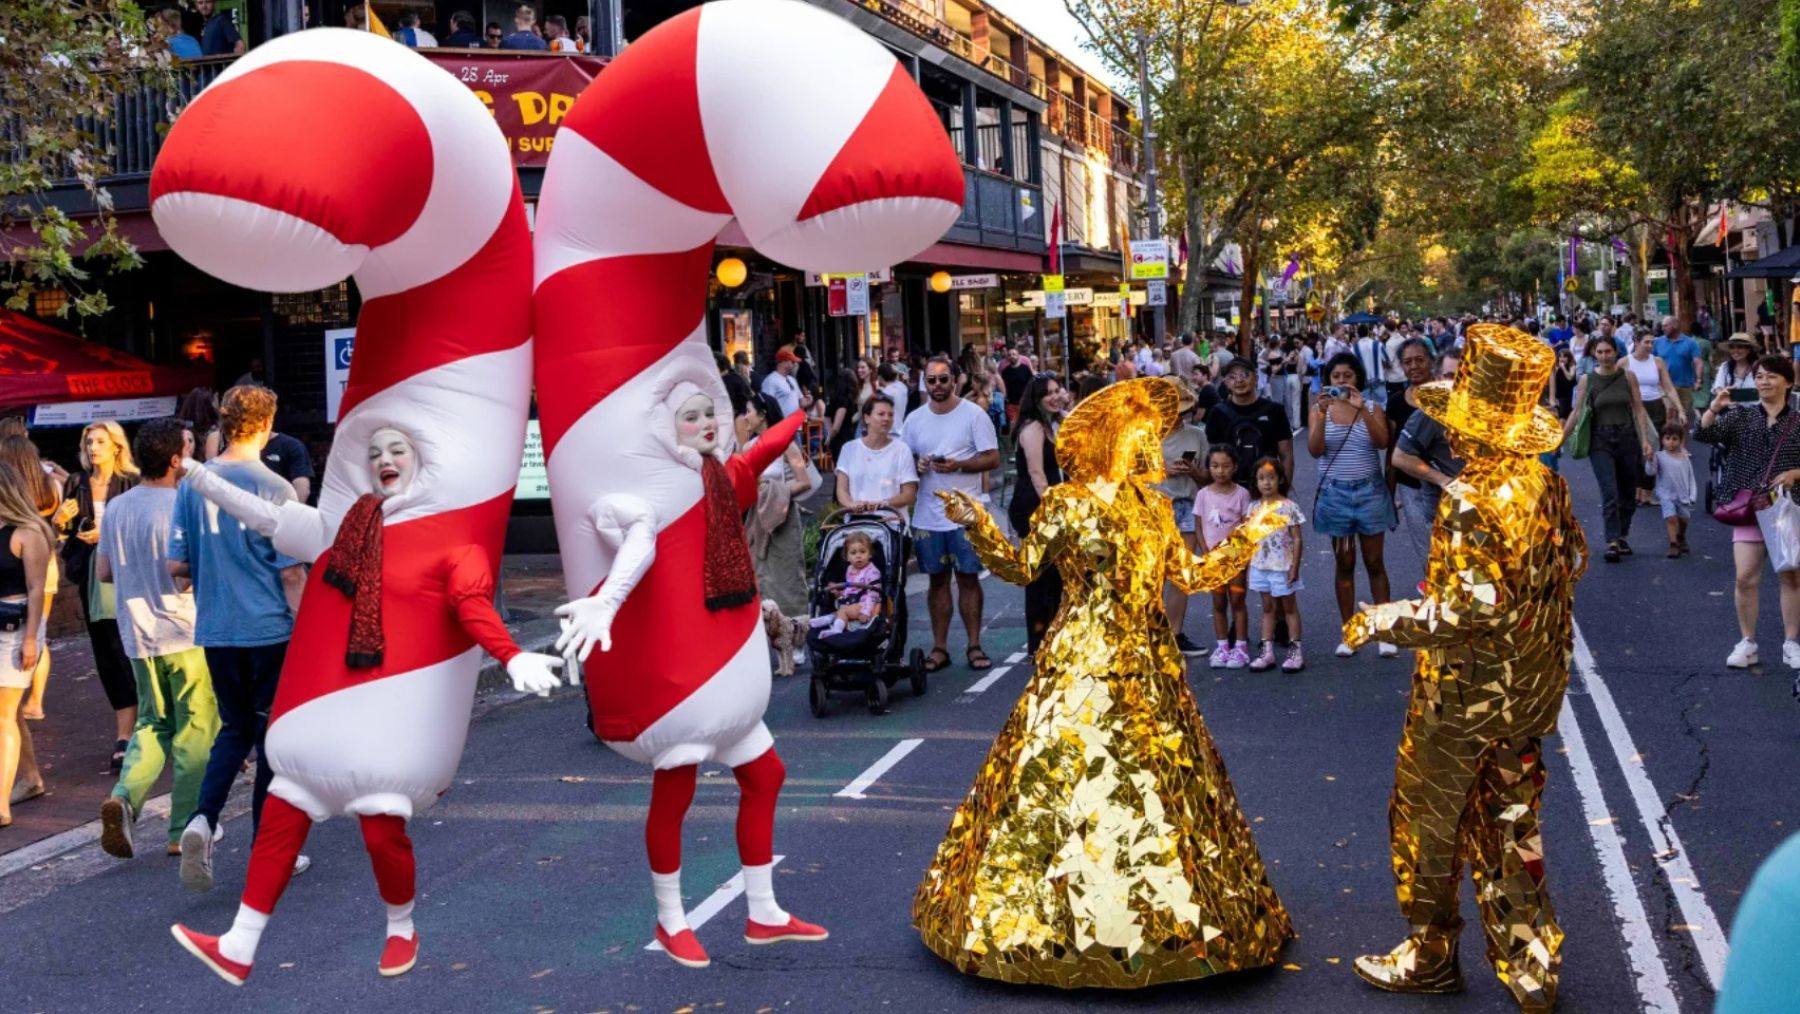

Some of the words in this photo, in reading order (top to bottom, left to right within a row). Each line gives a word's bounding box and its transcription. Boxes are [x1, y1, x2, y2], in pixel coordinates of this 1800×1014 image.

[482, 69, 510, 87] Apr
[511, 91, 581, 125] DA
[1067, 291, 1087, 301] ERY
[71, 377, 99, 394] THE
[104, 375, 150, 393] CLOCK
